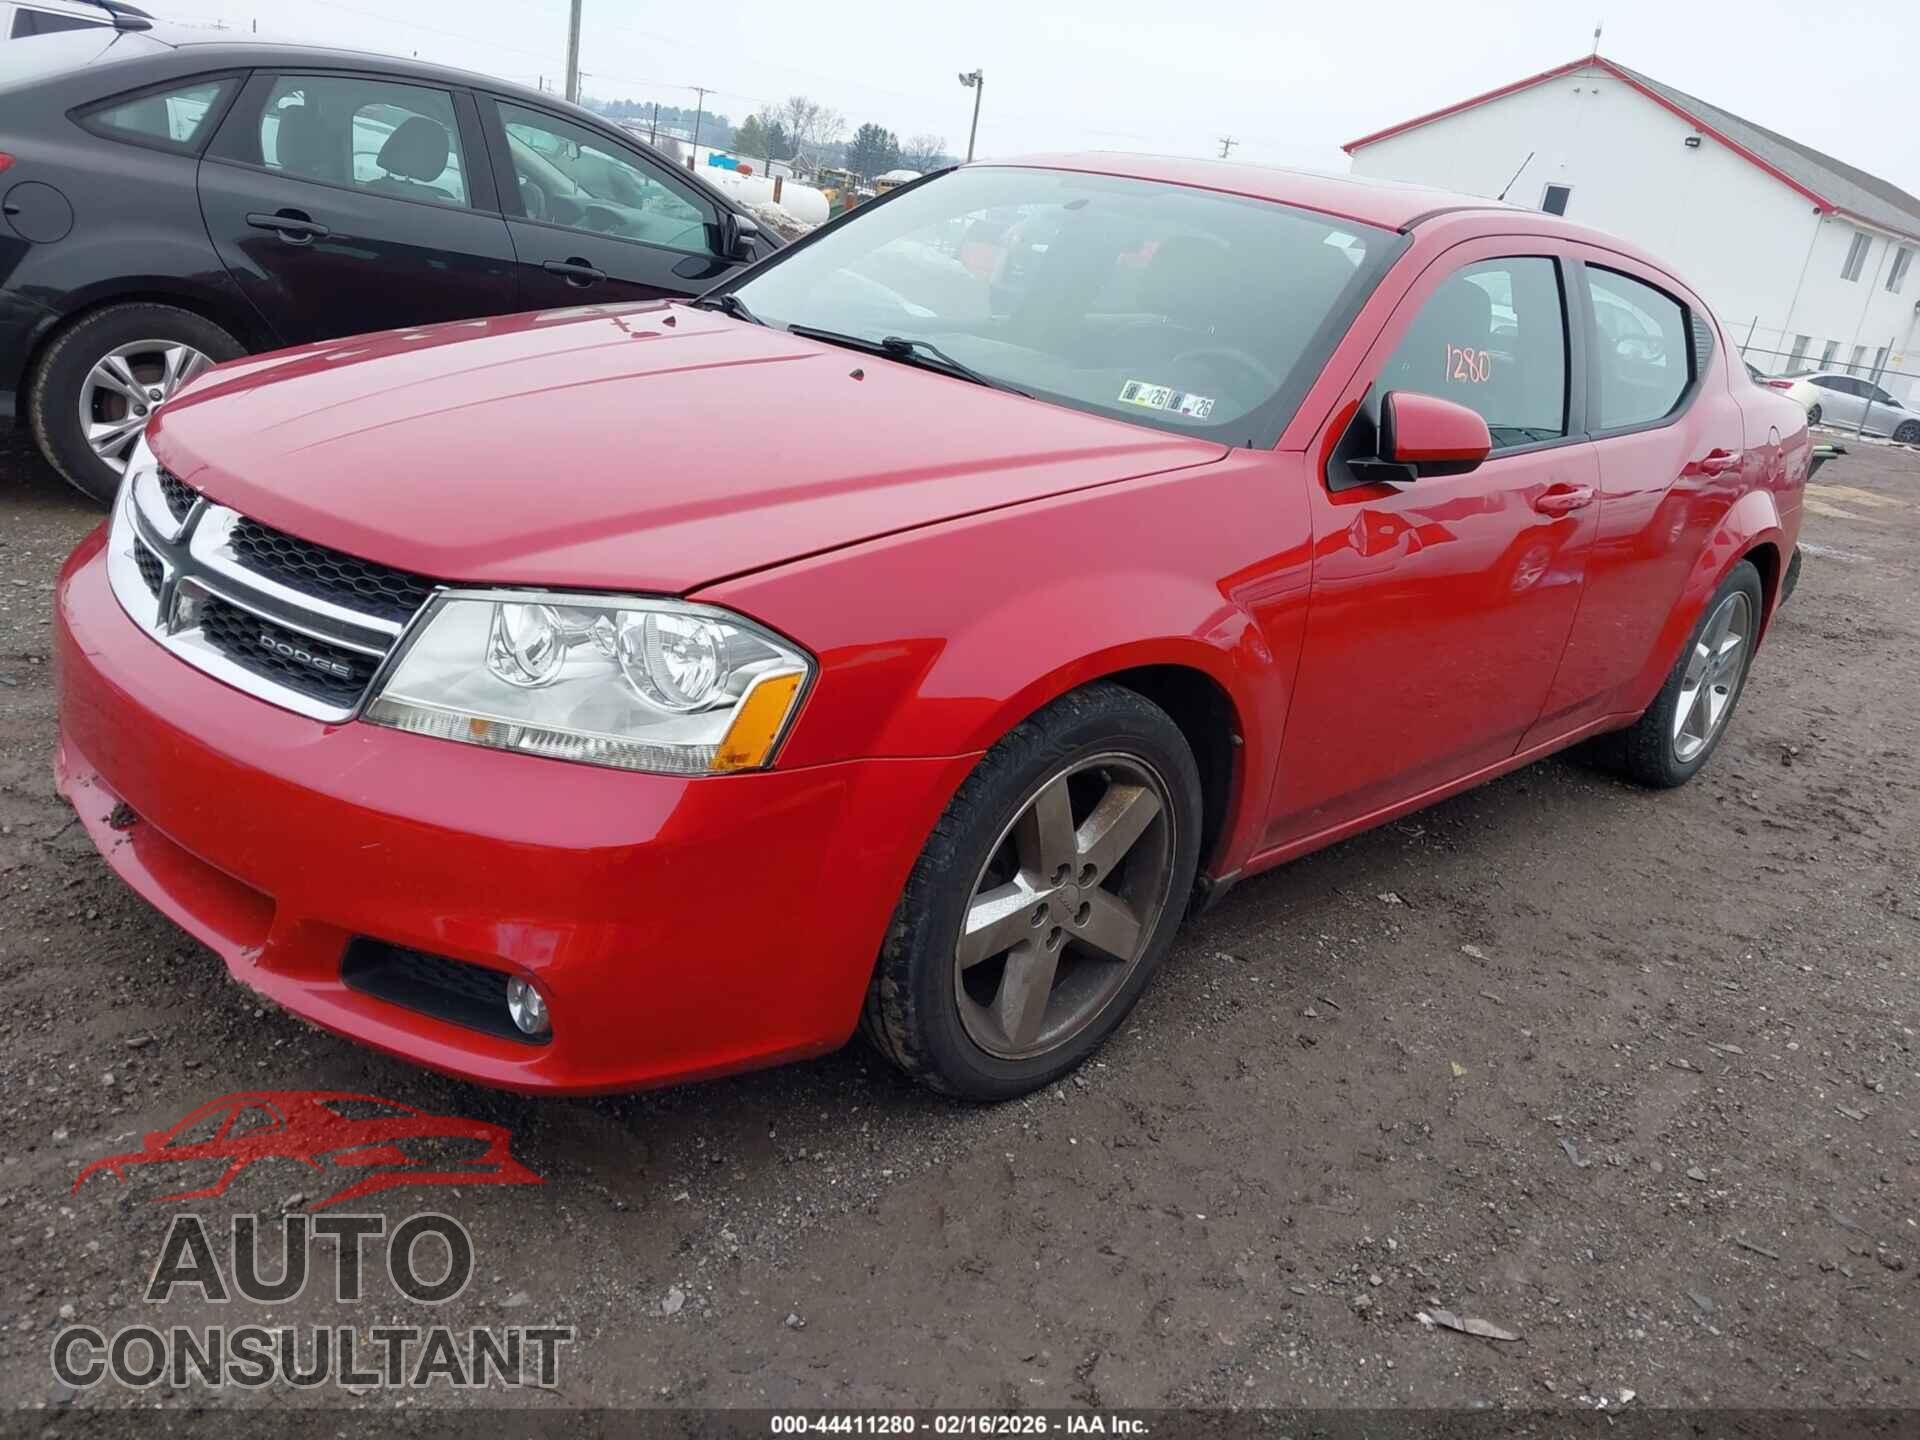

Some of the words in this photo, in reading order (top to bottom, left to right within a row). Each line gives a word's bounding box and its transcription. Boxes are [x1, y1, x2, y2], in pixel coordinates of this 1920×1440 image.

[1446, 344, 1491, 383] 1280
[1196, 400, 1212, 417] 26
[259, 634, 352, 678] DODGE
